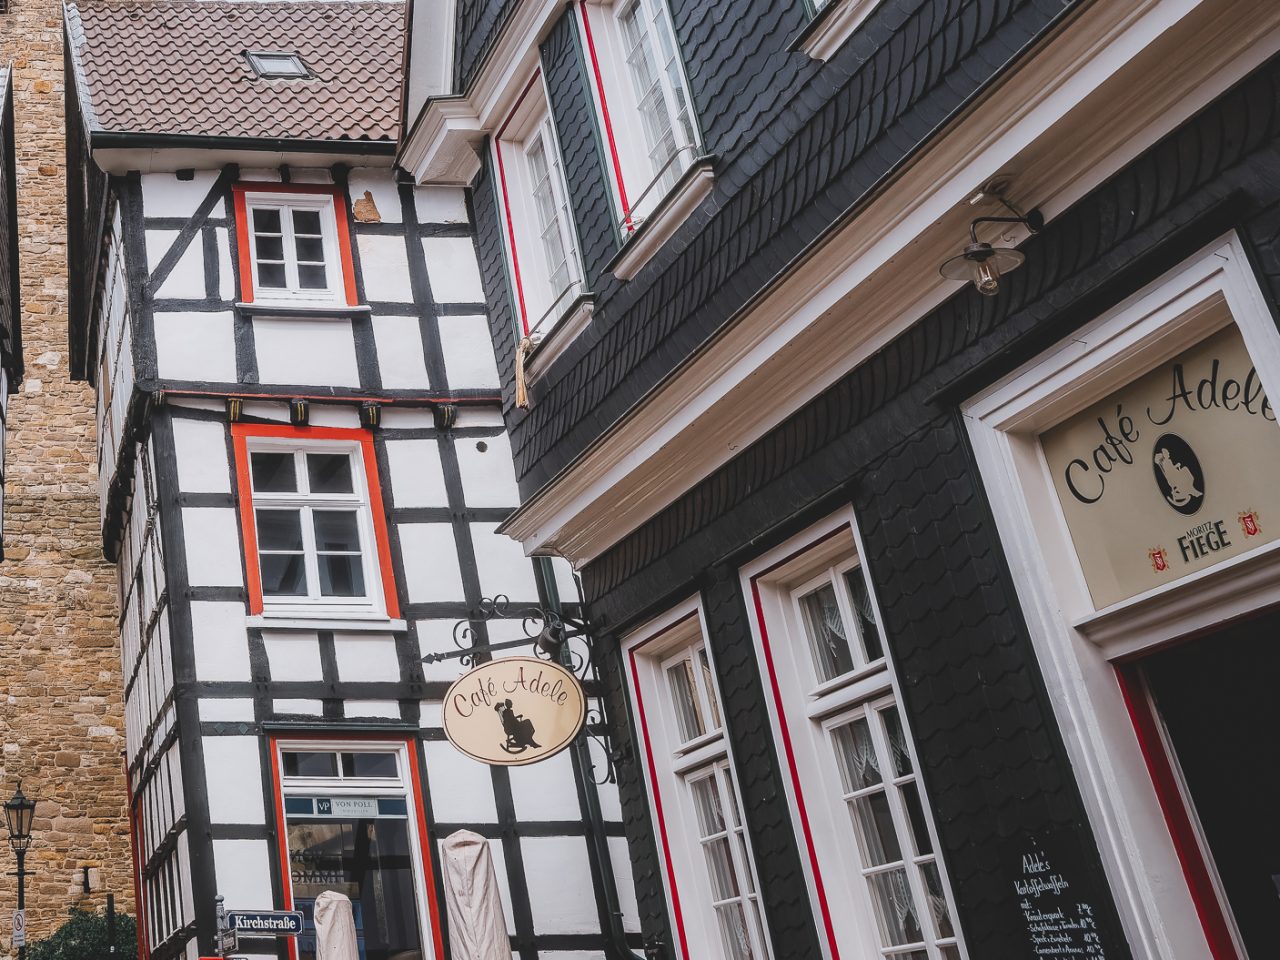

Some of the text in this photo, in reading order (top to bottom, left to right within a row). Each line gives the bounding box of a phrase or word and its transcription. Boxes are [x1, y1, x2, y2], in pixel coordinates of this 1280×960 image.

[1065, 404, 1139, 504] Café
[1177, 520, 1232, 563] FIEGE
[1186, 521, 1214, 540] MORITZ
[453, 666, 568, 717] Café Adele
[318, 802, 330, 811] VP
[235, 915, 296, 929] Kirchstraße
